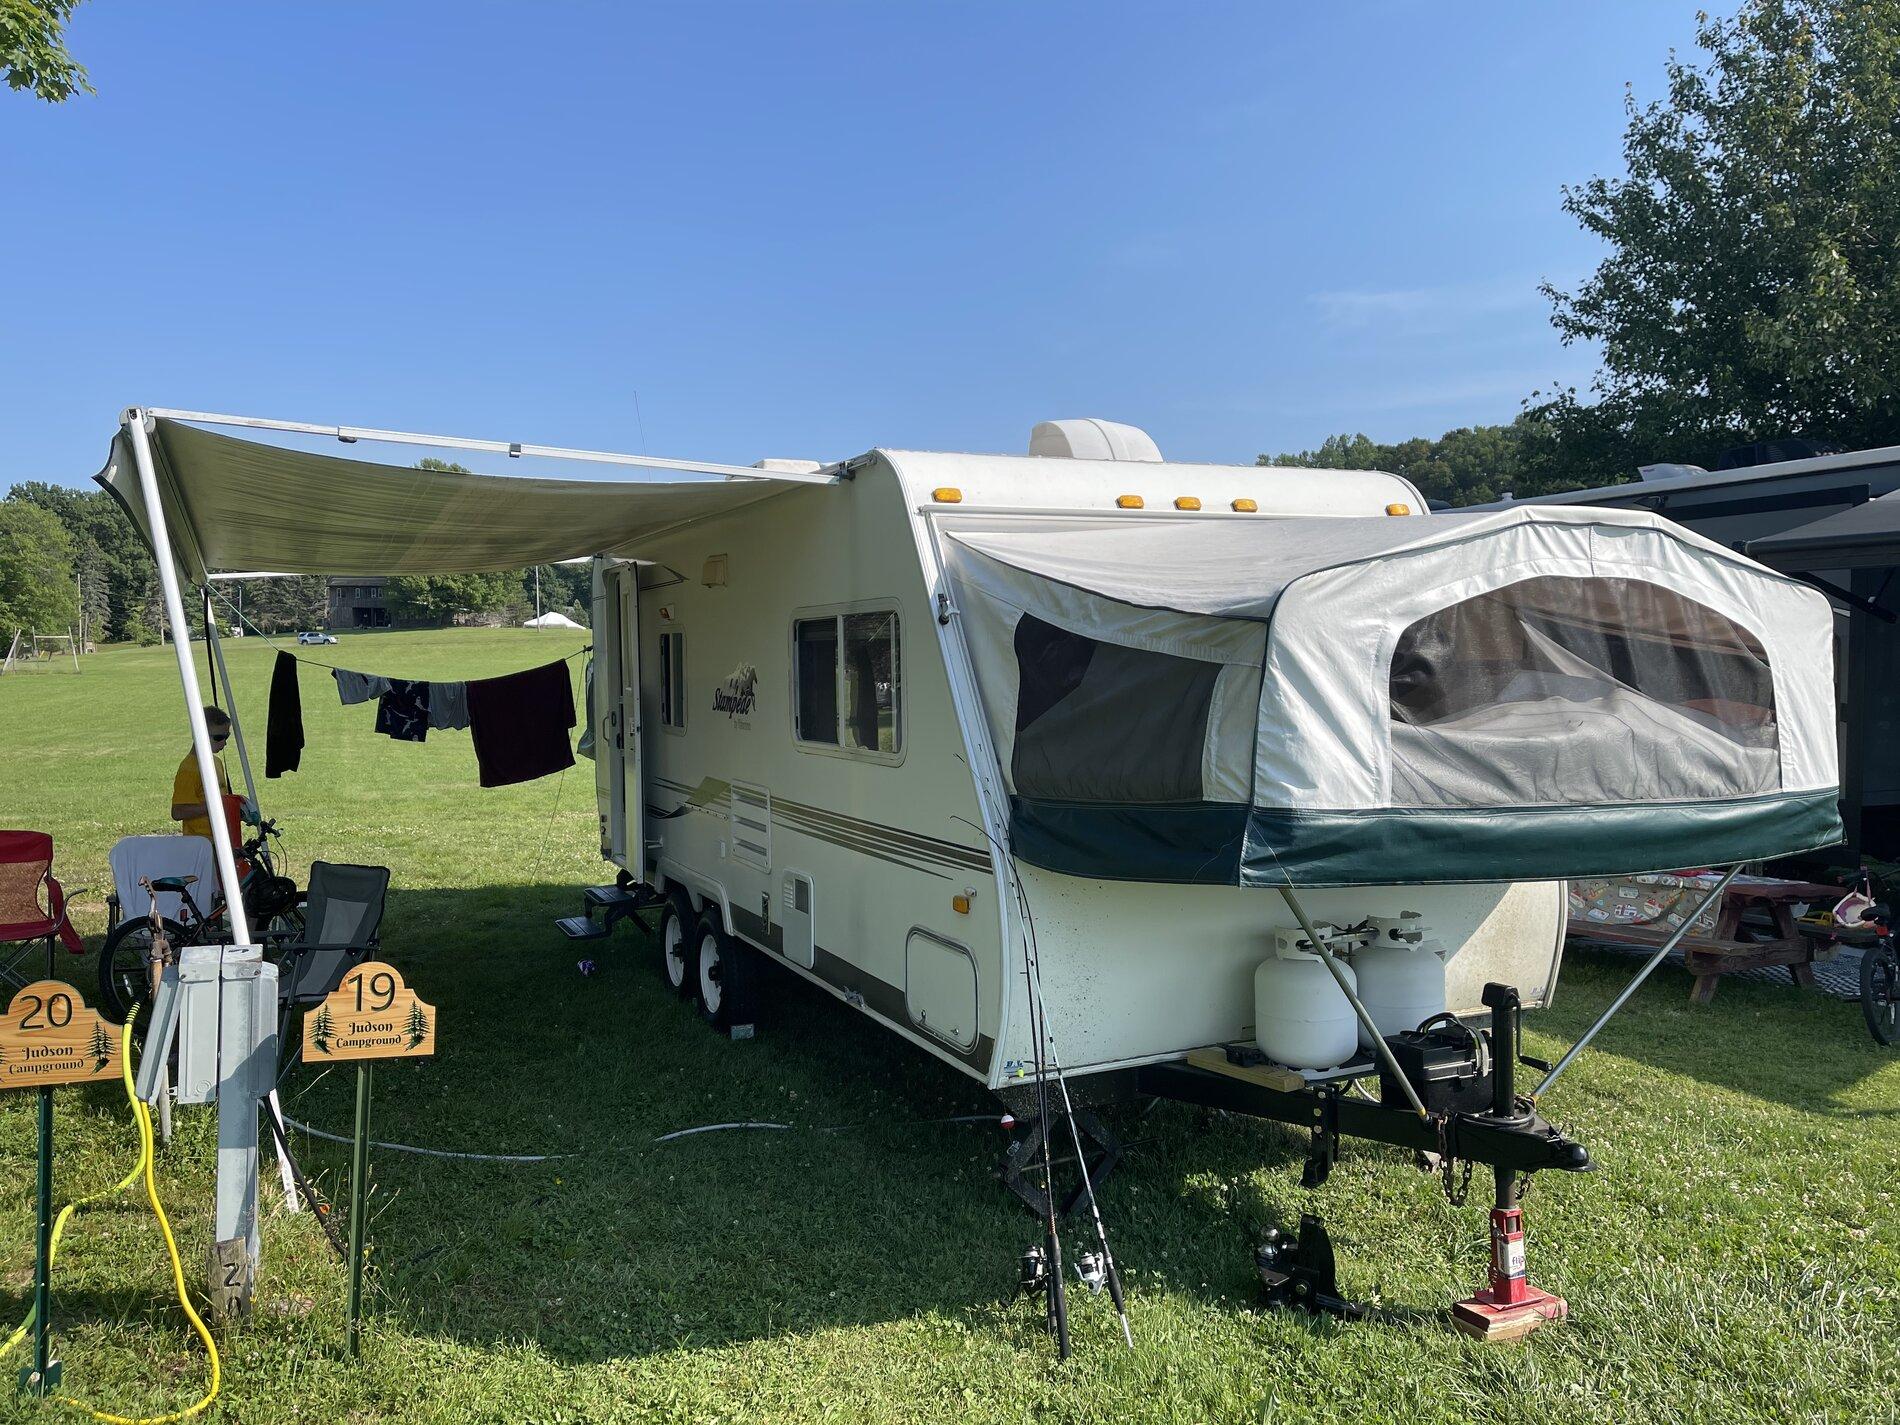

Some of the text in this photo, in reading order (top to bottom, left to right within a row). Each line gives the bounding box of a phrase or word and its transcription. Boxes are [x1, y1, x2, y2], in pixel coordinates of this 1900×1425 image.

[347, 972, 396, 1012] 19
[19, 993, 72, 1030] 20
[348, 1021, 393, 1036] Judson
[336, 1035, 402, 1049] Campground
[21, 1045, 73, 1060] Judson
[9, 1059, 84, 1075] Campground
